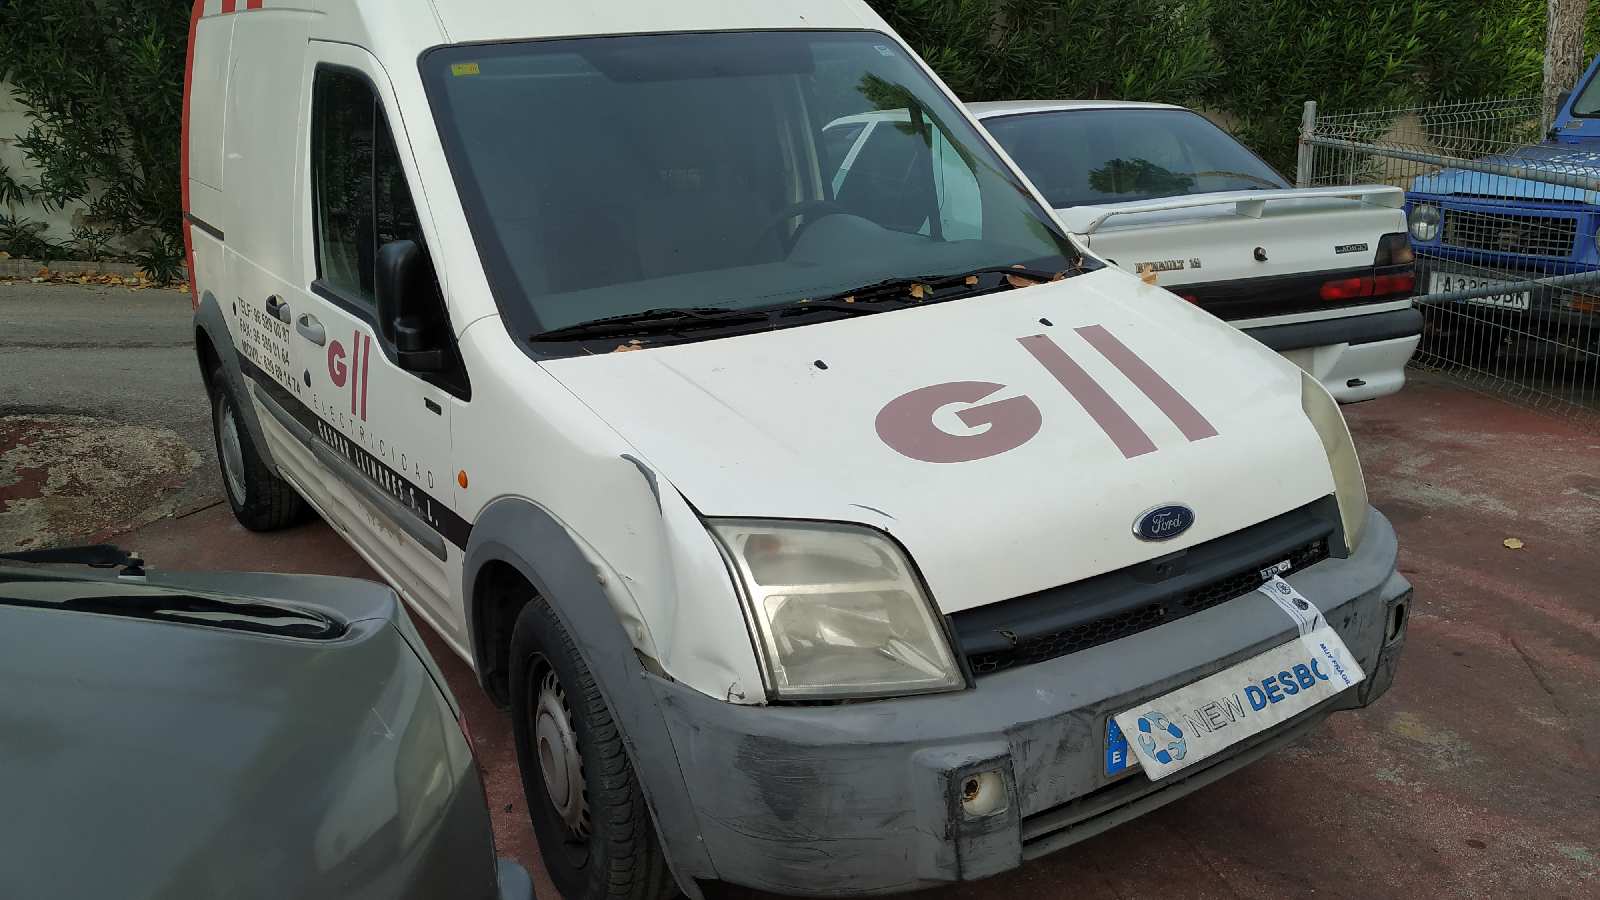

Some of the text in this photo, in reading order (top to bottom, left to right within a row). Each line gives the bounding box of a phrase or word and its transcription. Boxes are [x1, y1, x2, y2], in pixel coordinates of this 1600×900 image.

[313, 393, 434, 489] ELECTRICIDAD
[1151, 511, 1182, 533] Ford
[1320, 643, 1333, 658] MUY
[1182, 692, 1247, 738] NEW
[1112, 751, 1121, 764] E
